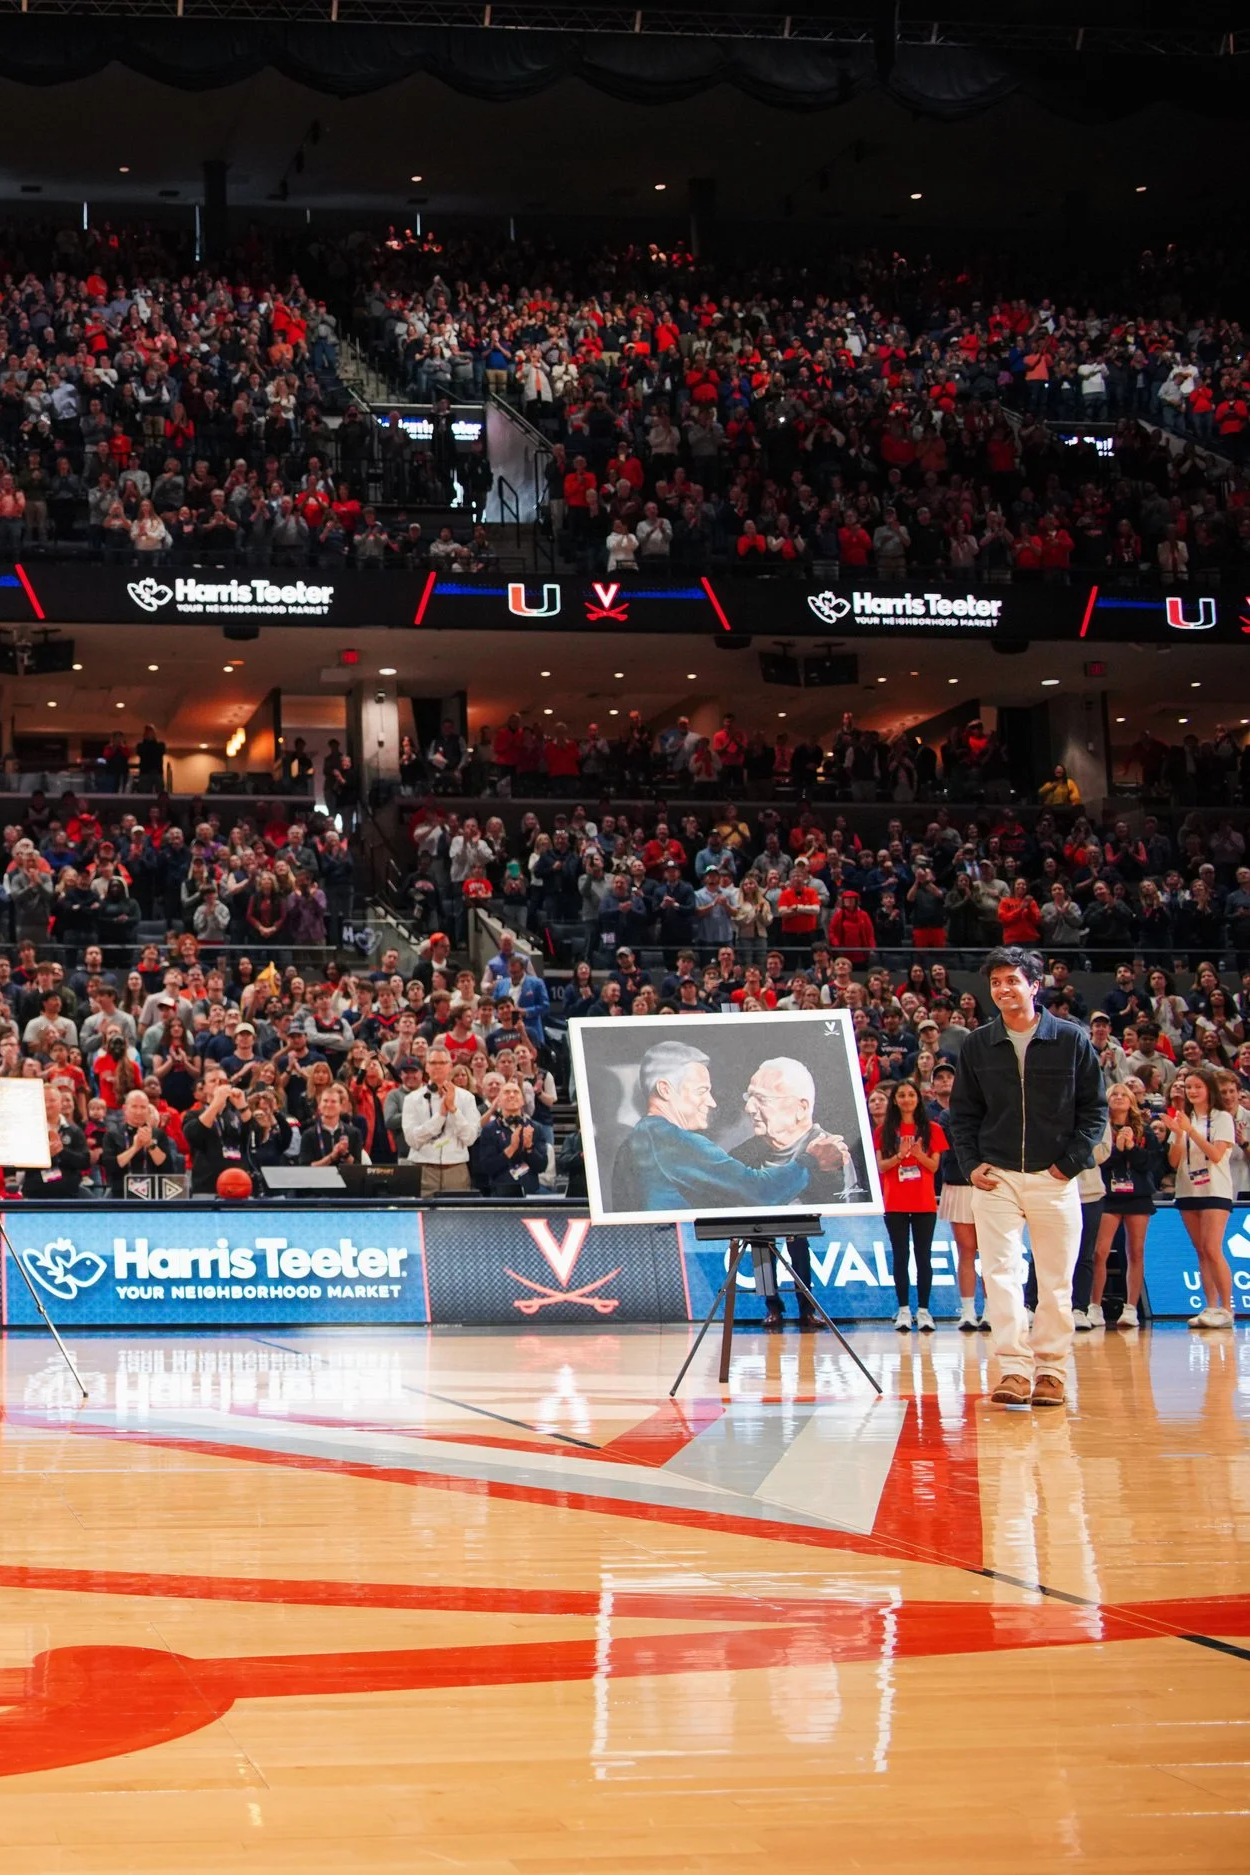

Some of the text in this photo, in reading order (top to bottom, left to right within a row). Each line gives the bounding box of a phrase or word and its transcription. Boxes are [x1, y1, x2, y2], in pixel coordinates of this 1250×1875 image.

[174, 578, 334, 605] Harris Teeter
[507, 582, 561, 617] U
[852, 591, 1003, 617] Harris Teeter
[176, 604, 329, 615] YOUR NEIGHBORHOOD MARKET
[855, 616, 999, 627] YOUR NEIGHBORHOOD MARKET
[1165, 596, 1217, 630] U
[113, 1237, 407, 1280] Harris Teeter
[116, 1285, 402, 1300] YOUR NEIGHBORHOOD MARKET
